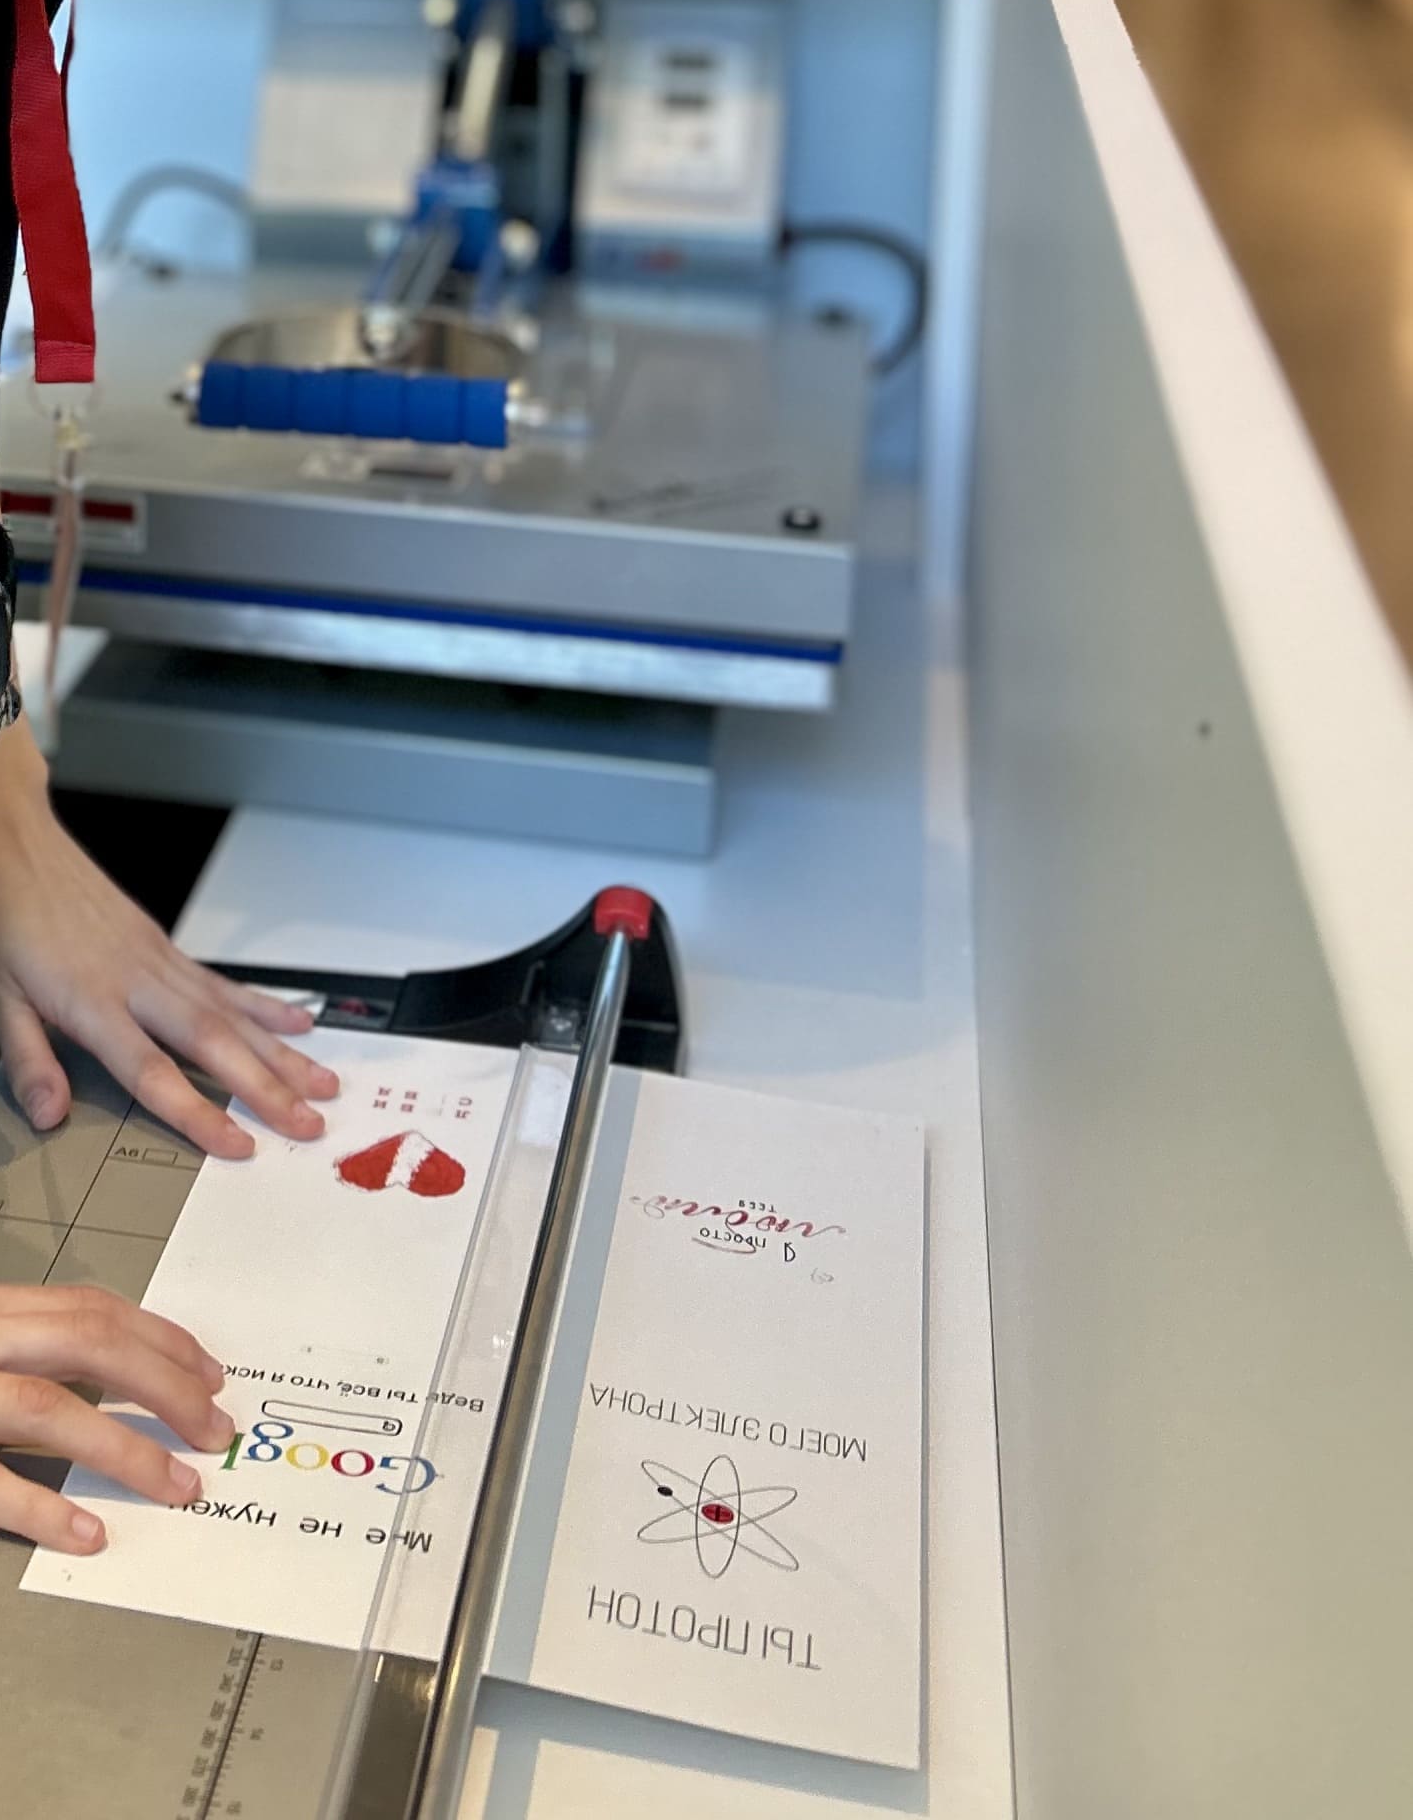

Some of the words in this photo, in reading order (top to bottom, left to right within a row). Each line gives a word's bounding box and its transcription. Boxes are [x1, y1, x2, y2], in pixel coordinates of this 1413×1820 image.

[783, 1241, 796, 1262] Я
[220, 1364, 265, 1381] иск
[270, 1371, 286, 1383] я
[290, 1375, 330, 1391] что
[337, 1380, 381, 1398] всё,
[386, 1388, 419, 1404] ты
[426, 1391, 485, 1413] Ведь
[589, 1382, 761, 1441] ЭЛЕКТРОНА
[769, 1422, 867, 1462] МОЕГО
[219, 1420, 438, 1496] Googl
[169, 1500, 277, 1528] нуже
[299, 1516, 343, 1538] не
[366, 1527, 433, 1554] Мне
[587, 1585, 751, 1656] ПРОТОН
[762, 1624, 823, 1671] ТЫ
